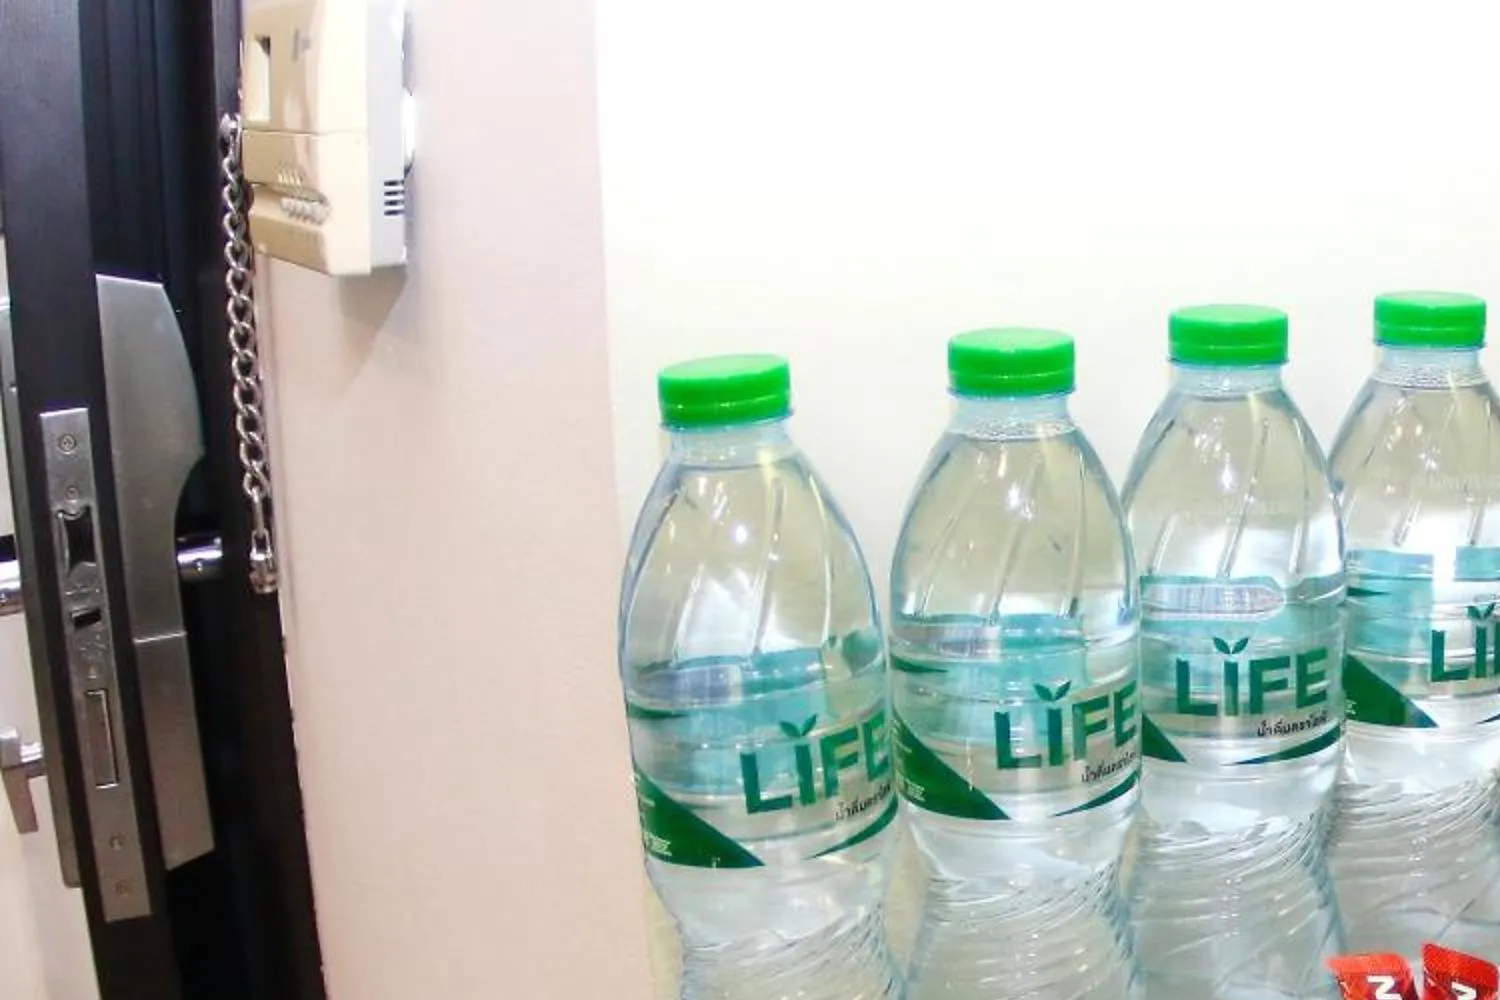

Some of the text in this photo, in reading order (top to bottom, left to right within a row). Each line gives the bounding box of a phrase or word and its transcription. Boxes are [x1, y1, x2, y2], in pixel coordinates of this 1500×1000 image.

[1176, 638, 1328, 716] LIFE
[741, 709, 890, 814] LIFE
[995, 680, 1137, 770] LIFE
